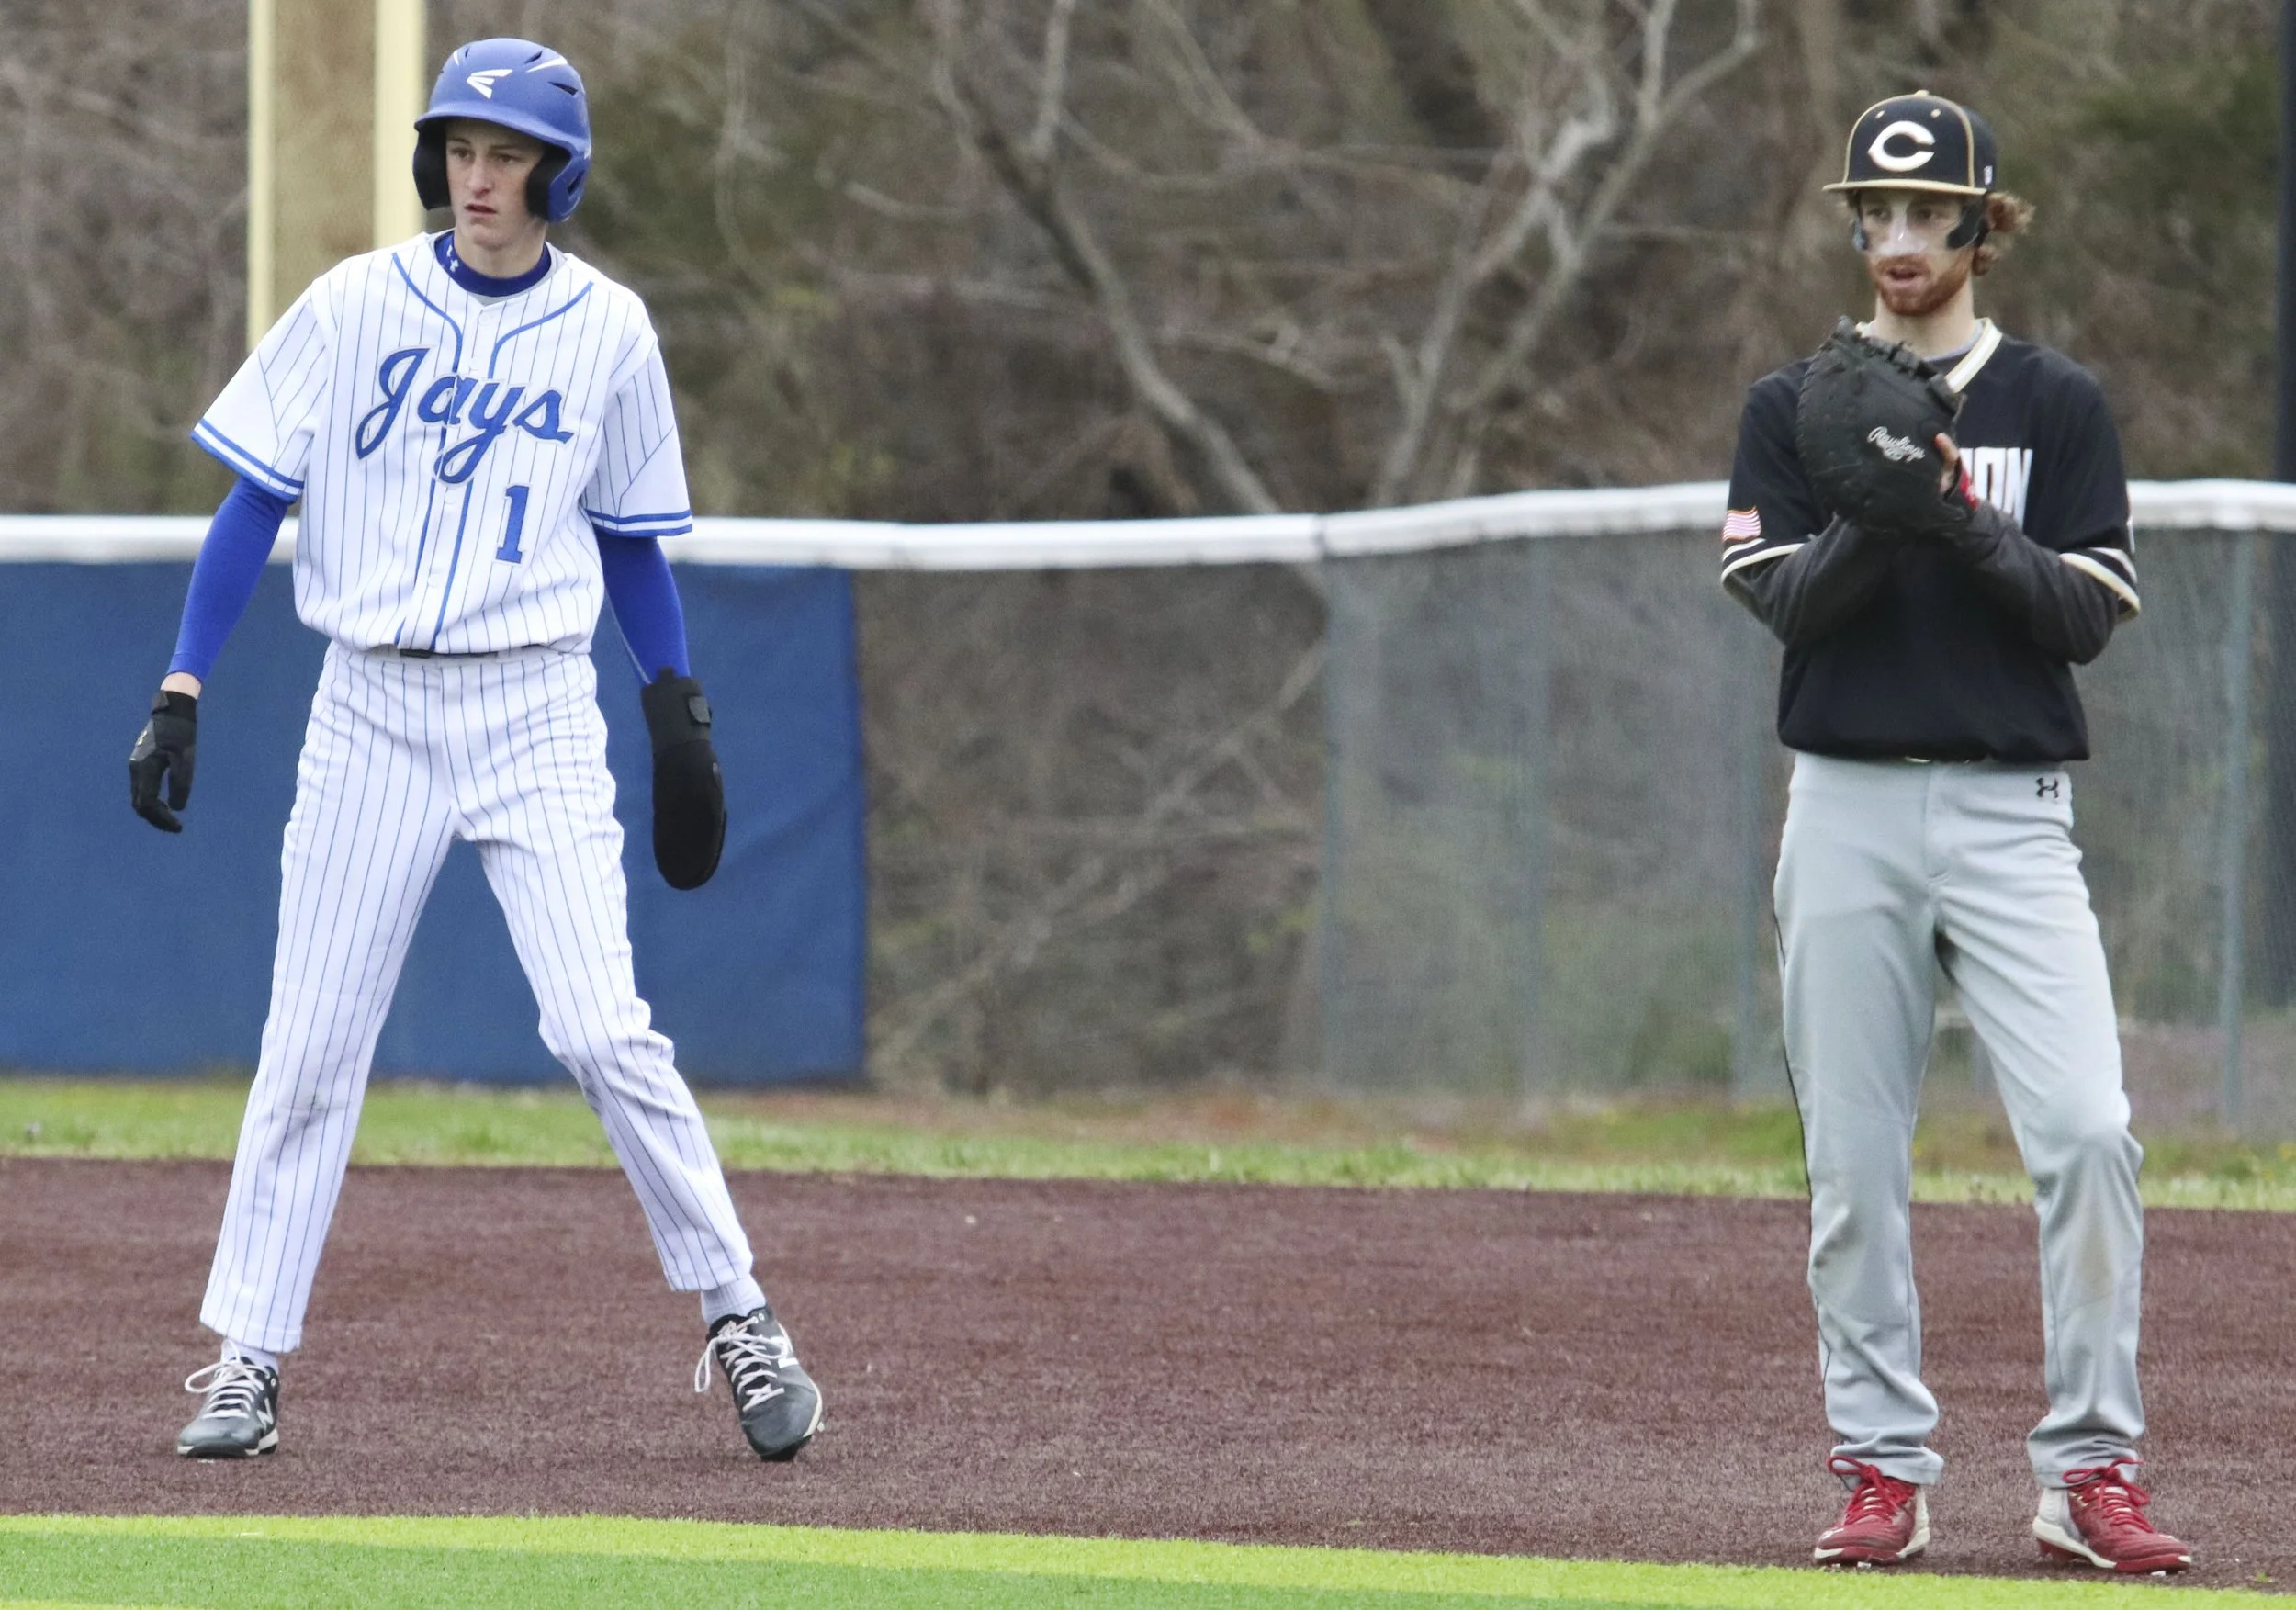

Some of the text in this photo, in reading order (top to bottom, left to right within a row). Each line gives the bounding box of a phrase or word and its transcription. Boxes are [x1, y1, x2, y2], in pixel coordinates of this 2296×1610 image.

[1868, 120, 1935, 172] C
[355, 346, 575, 484] Jays
[1867, 426, 1926, 463] Rawlings
[495, 484, 530, 564] 1
